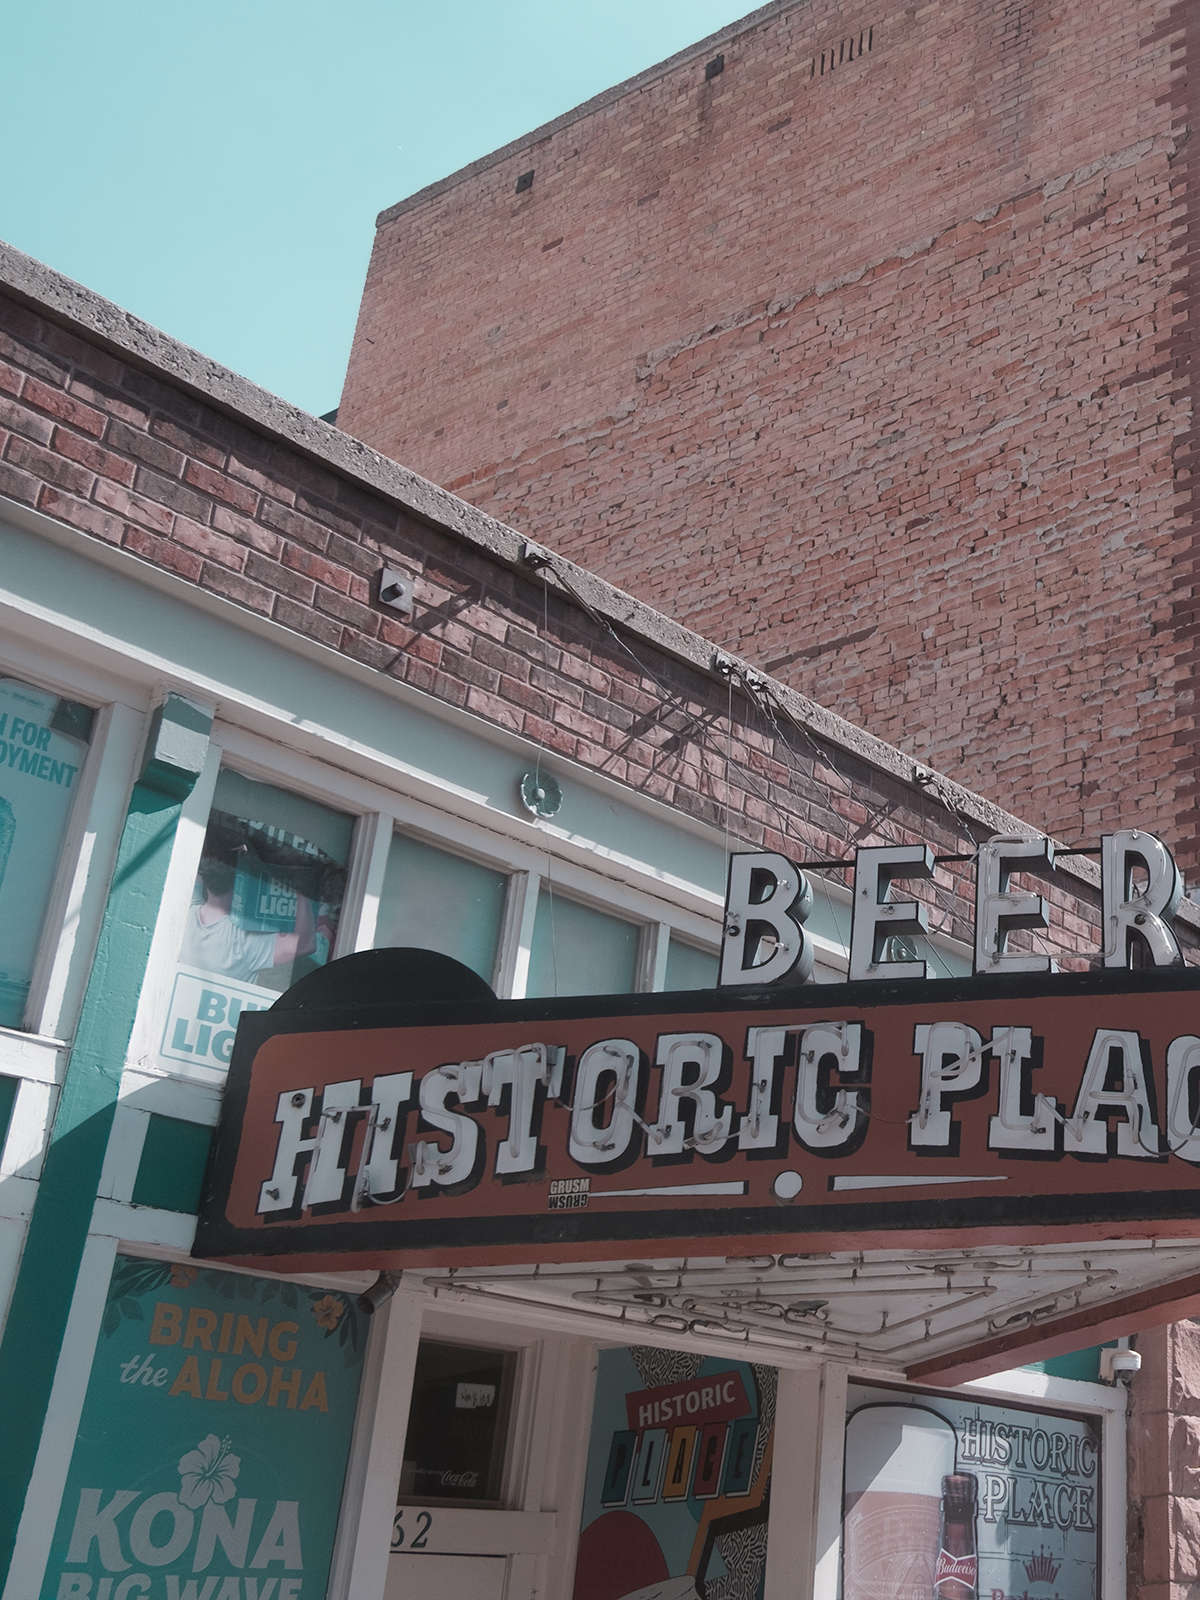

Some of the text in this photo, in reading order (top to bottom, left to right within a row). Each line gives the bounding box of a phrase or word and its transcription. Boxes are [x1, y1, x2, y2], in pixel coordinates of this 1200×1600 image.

[9, 717, 52, 752] FOR
[718, 831, 1186, 988] BEER
[256, 1022, 867, 1214] HISTORIC
[550, 1178, 590, 1194] GRUSM
[149, 1302, 300, 1362] BRING
[120, 1353, 329, 1412] the ALOHA
[638, 1380, 736, 1427] HISTORIC
[611, 1432, 749, 1489] PLACE
[962, 1417, 1098, 1478] HISTORIC
[64, 1488, 304, 1573] KONA
[984, 1474, 1096, 1533] PLACE
